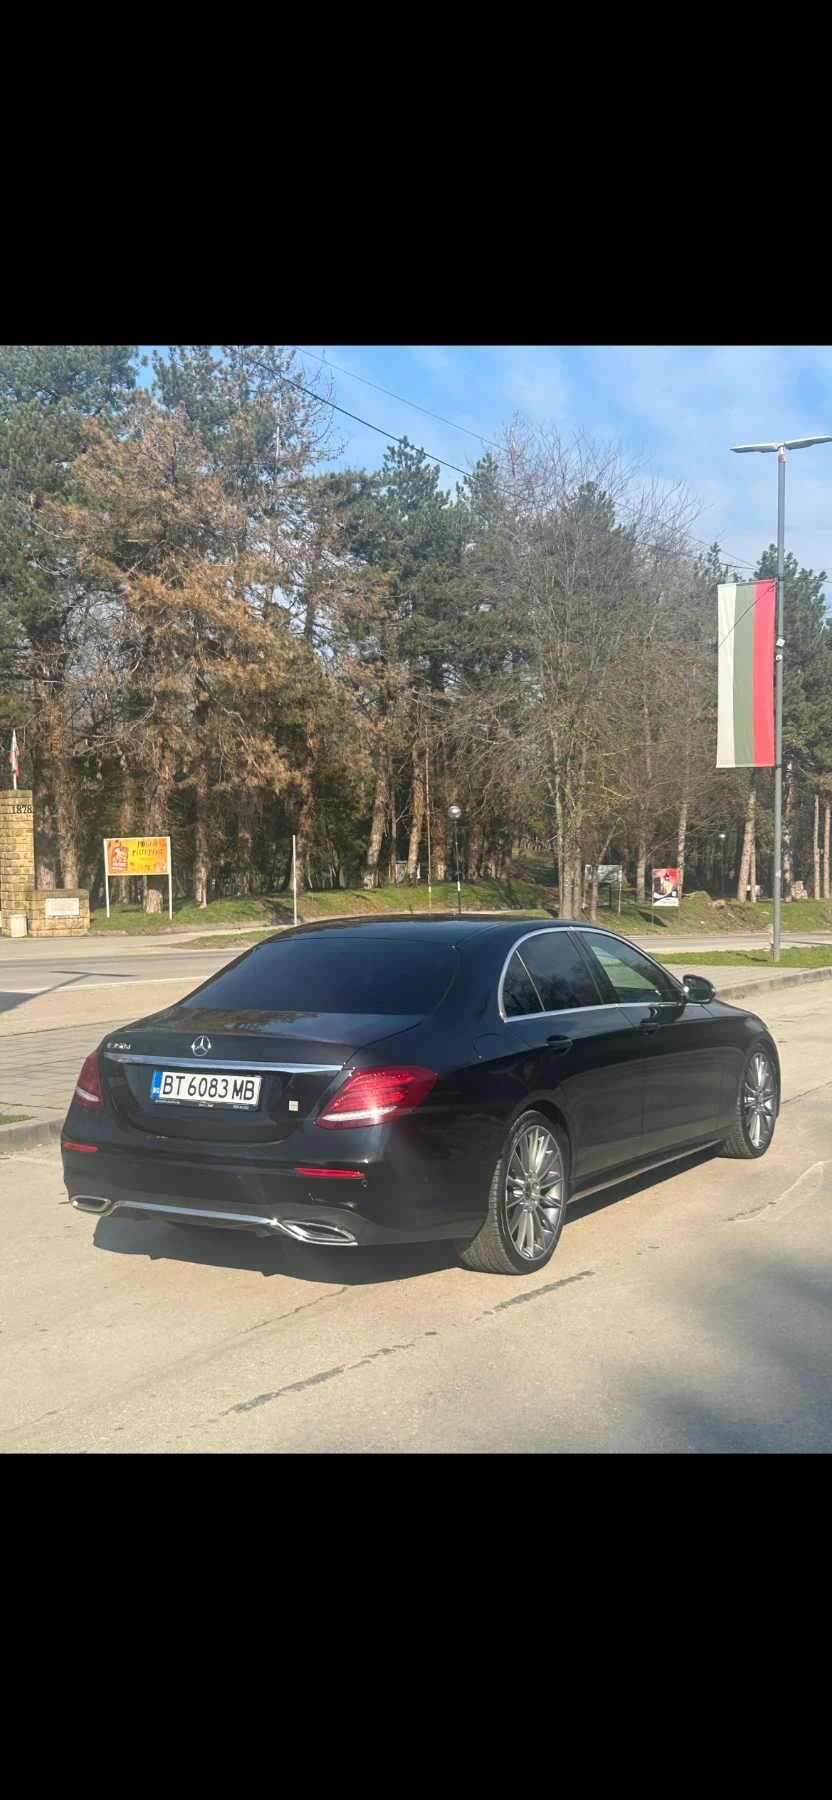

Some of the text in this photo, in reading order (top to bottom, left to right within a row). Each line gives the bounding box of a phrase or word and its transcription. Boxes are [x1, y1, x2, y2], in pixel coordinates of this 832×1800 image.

[12, 804, 33, 814] 1878
[162, 1075, 255, 1100] BT 6083 MB
